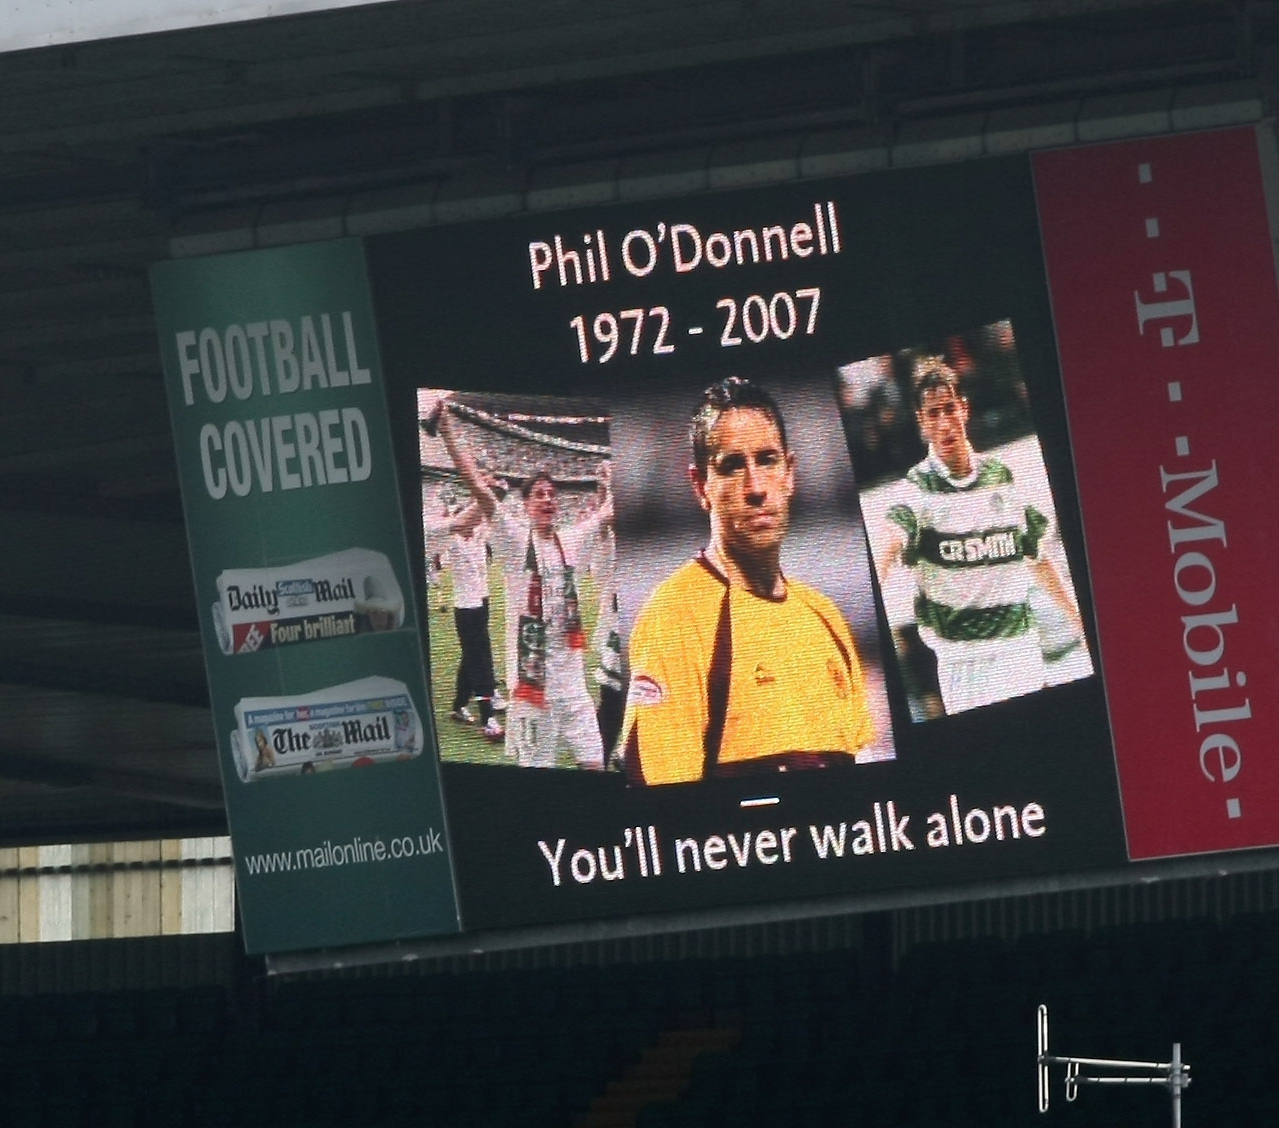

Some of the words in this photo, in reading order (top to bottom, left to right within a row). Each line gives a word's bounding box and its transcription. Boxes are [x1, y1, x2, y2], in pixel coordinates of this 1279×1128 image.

[528, 229, 610, 289] Phil
[621, 201, 841, 277] O'Donnell
[176, 311, 371, 406] FOOTBALL
[570, 306, 675, 364] 1972
[716, 287, 821, 348] 2007
[200, 407, 371, 499] COVERED
[226, 585, 279, 615] Daily
[313, 577, 357, 602] Mail
[271, 620, 302, 644] Four
[304, 614, 355, 639] brilliant
[273, 728, 311, 754] The
[342, 716, 391, 744] Mail
[245, 827, 444, 875] www.mailonline.co.uk
[538, 825, 662, 887] You'll
[675, 827, 798, 873] never
[809, 801, 915, 860] walk
[925, 794, 1047, 849] alone
